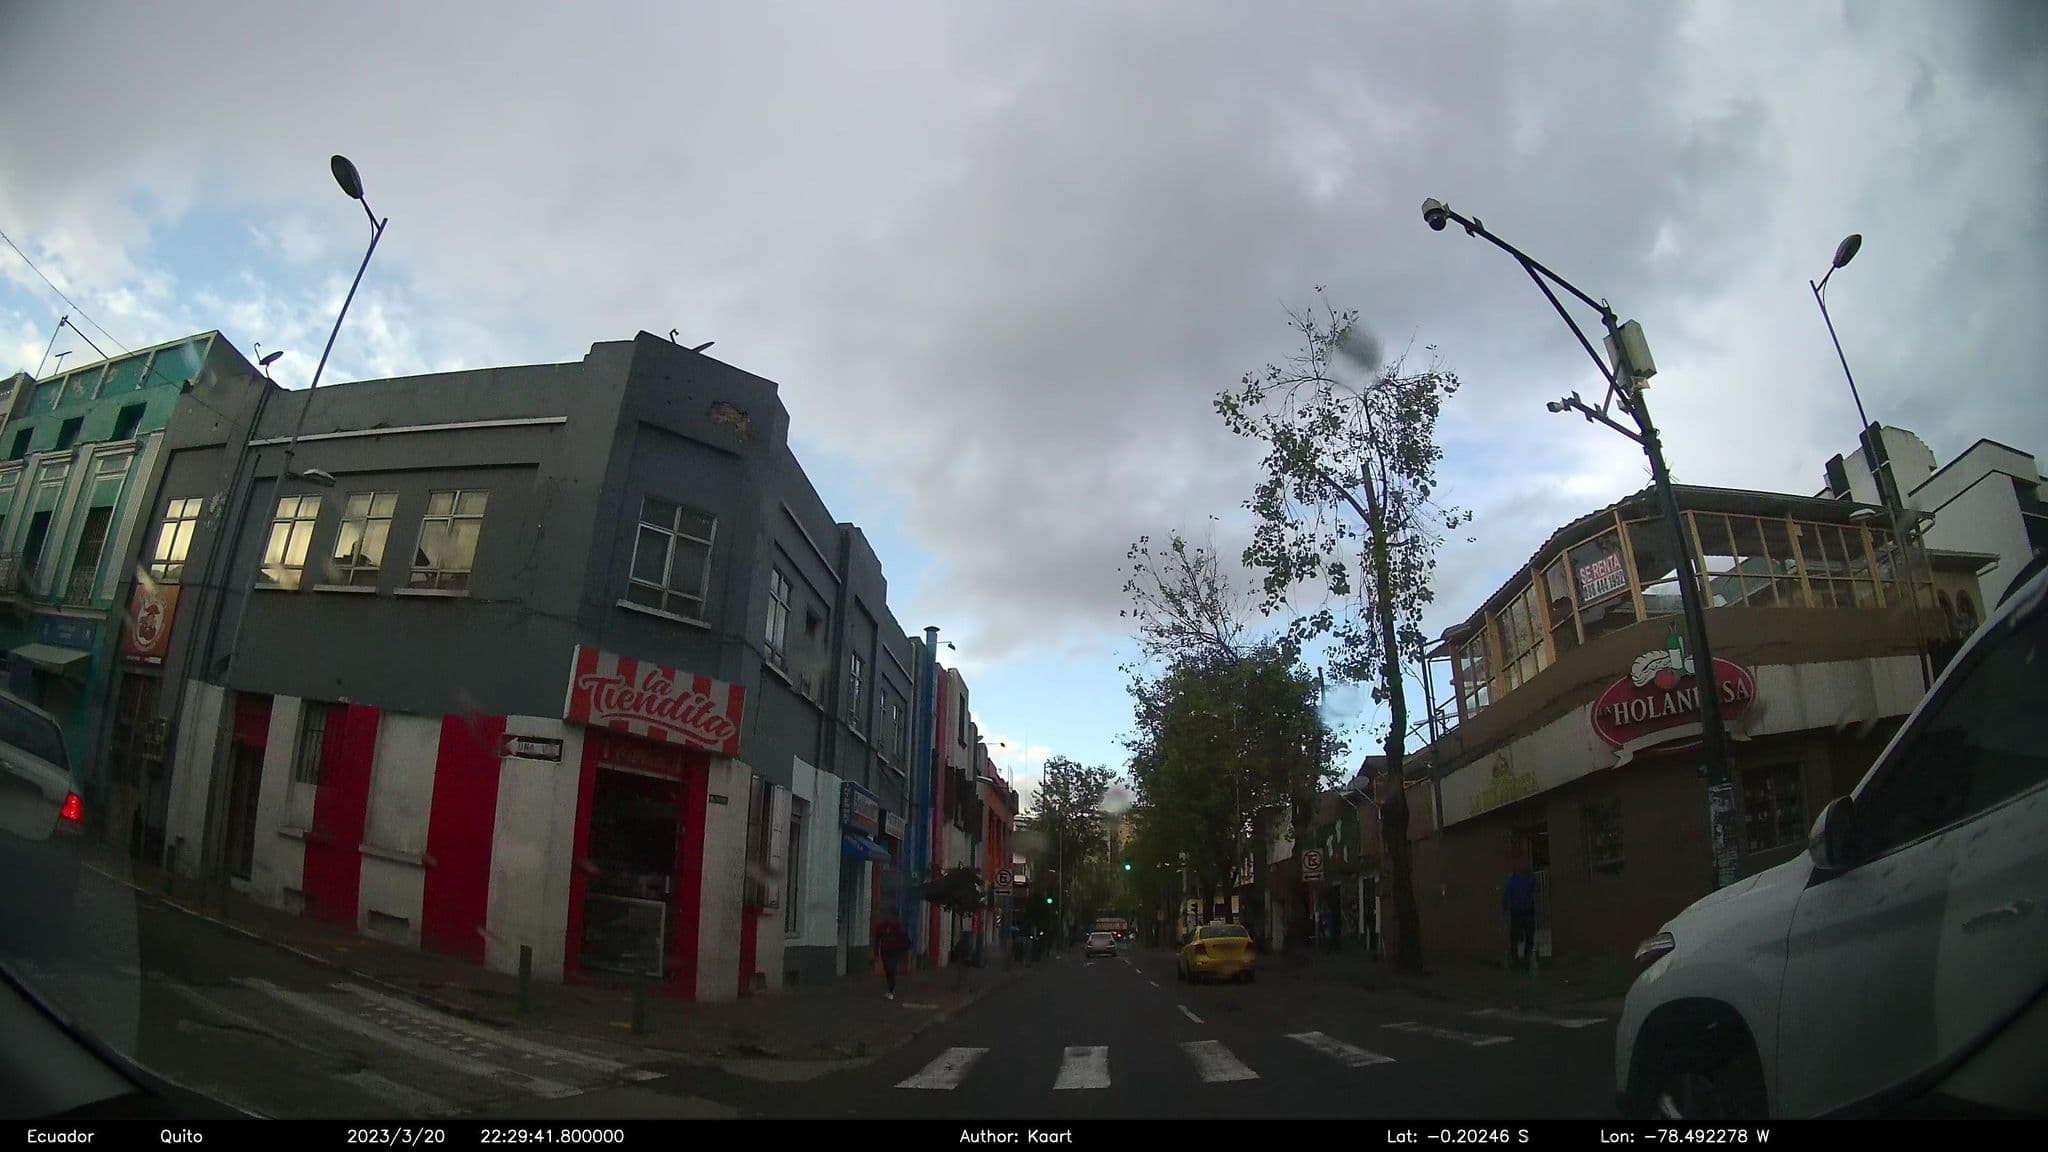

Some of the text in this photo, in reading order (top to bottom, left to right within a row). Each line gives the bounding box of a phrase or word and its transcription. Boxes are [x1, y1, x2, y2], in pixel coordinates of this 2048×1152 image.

[1580, 553, 1621, 584] SE RENTA
[642, 669, 673, 696] la
[1614, 677, 1749, 726] HOLANSA
[580, 676, 736, 738] Tiendita
